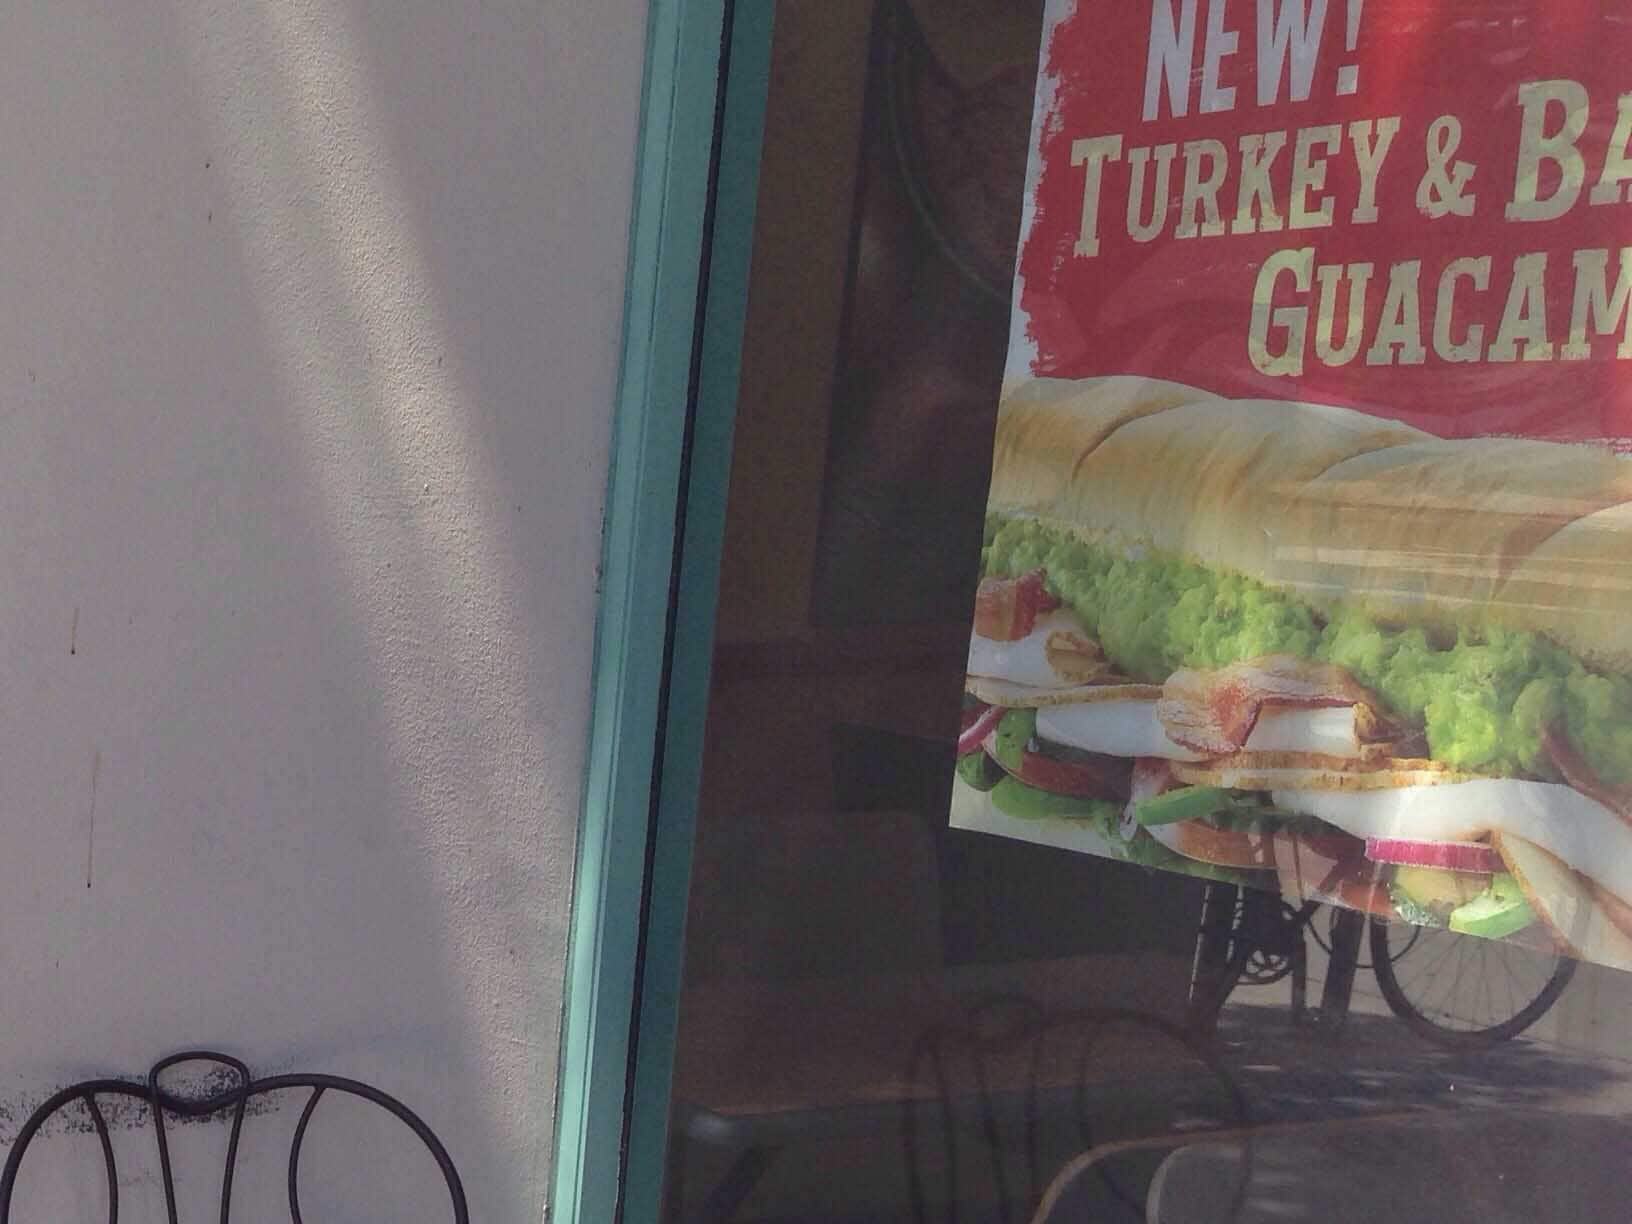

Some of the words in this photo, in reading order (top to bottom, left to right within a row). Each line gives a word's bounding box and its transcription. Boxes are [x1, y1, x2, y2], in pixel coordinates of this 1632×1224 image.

[1142, 0, 1364, 121] NEW!
[1071, 116, 1400, 257] TURKEY
[1416, 115, 1476, 218] &
[1247, 246, 1632, 377] GUACAM
